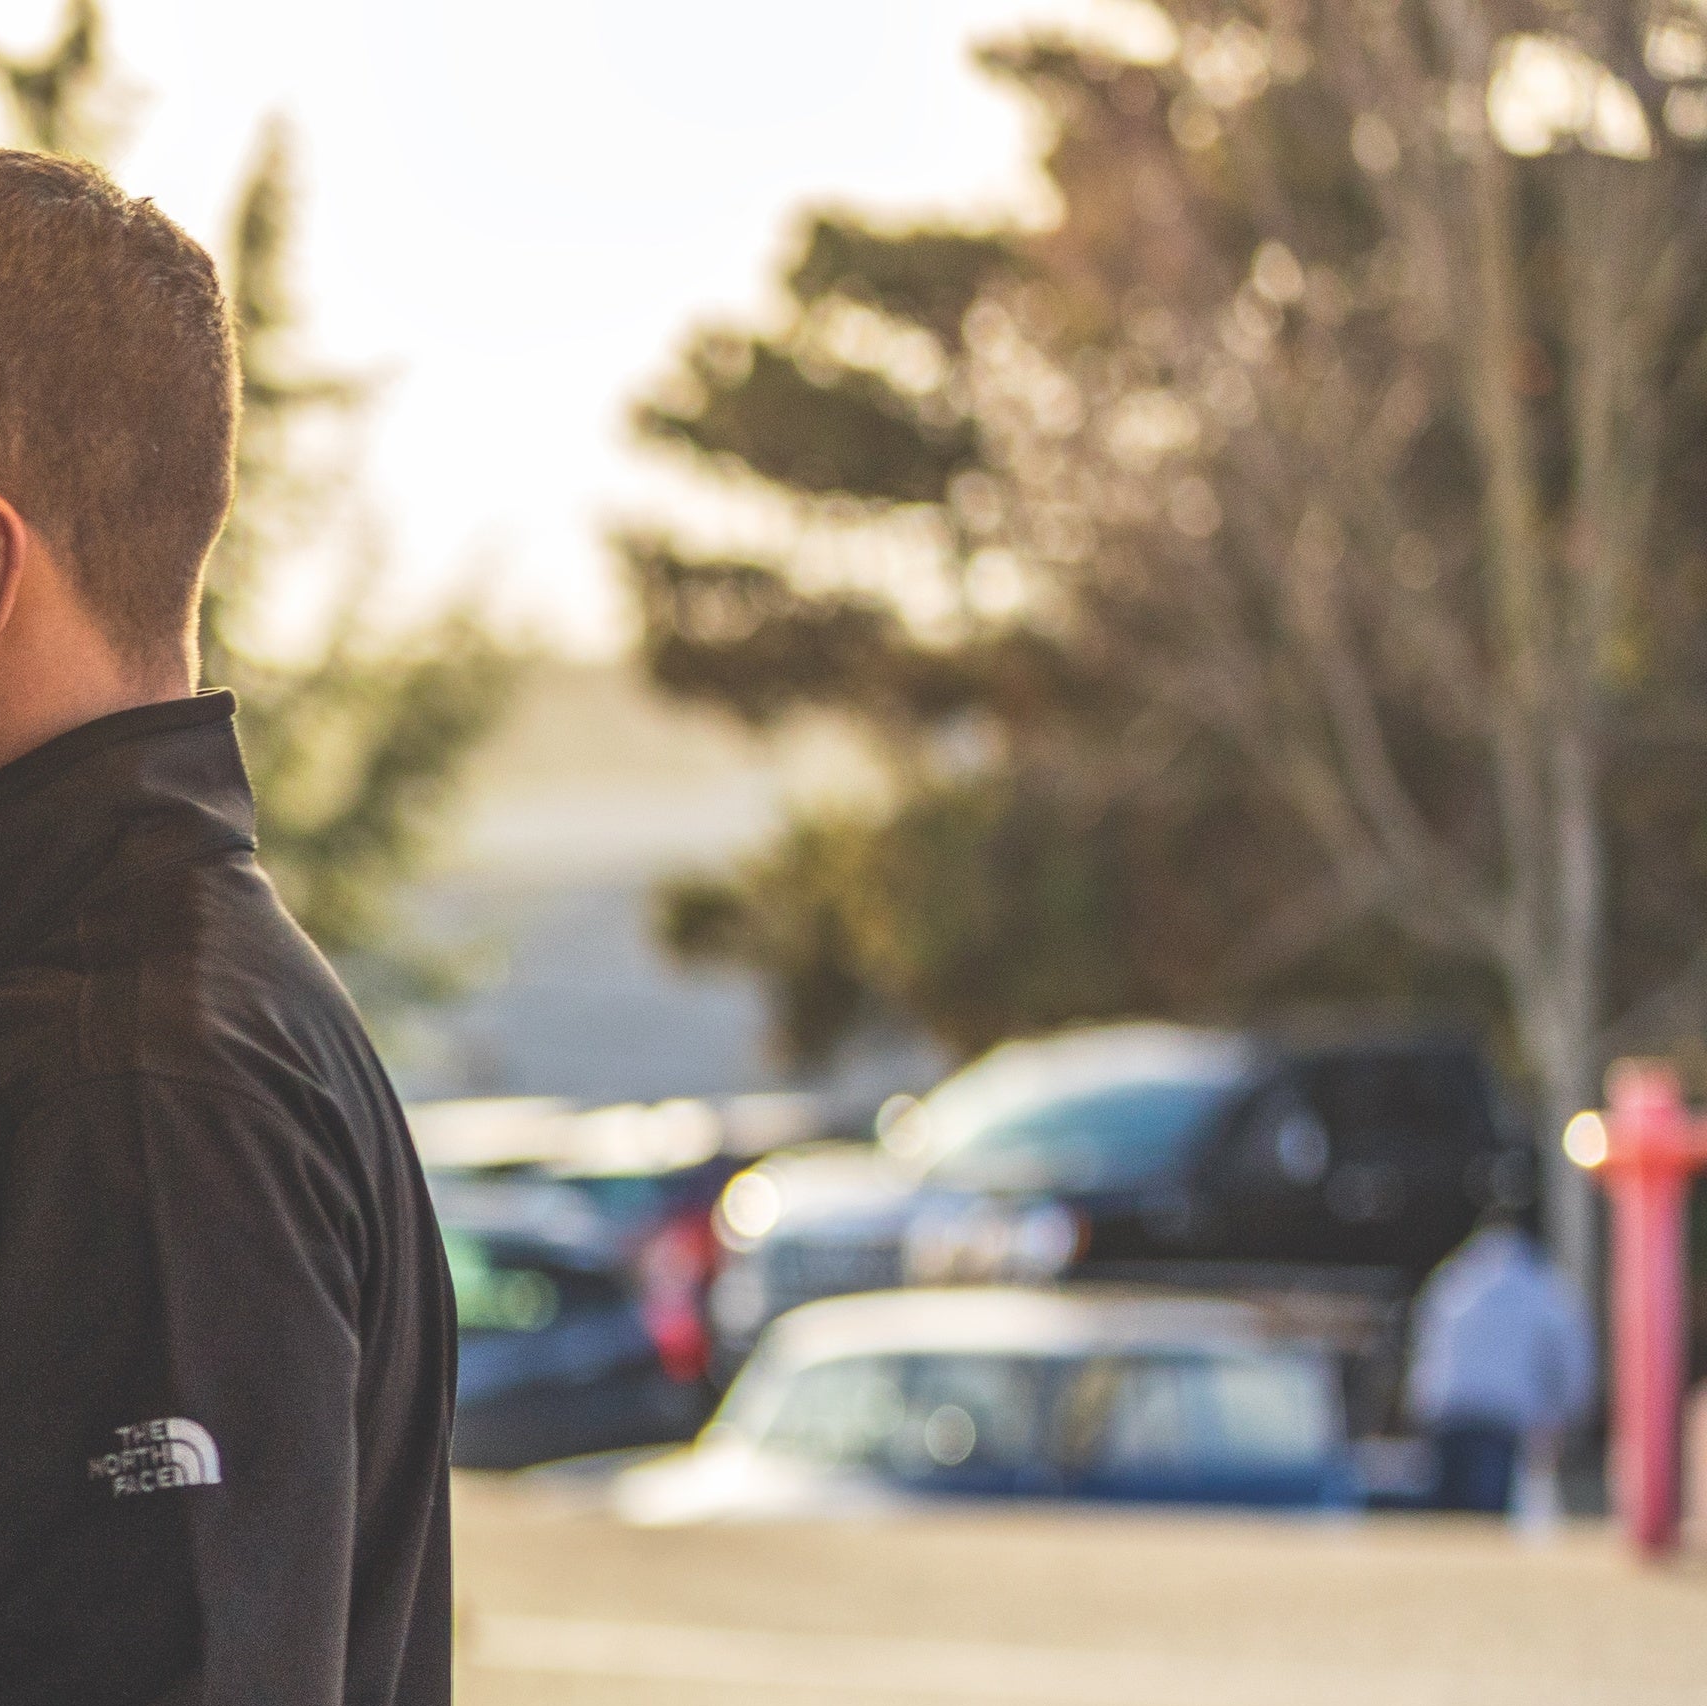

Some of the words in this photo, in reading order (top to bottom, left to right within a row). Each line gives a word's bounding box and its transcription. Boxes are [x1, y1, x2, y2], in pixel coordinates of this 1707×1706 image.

[113, 1419, 166, 1446] THE
[88, 1442, 172, 1480] NORTH
[113, 1466, 175, 1498] FACE
